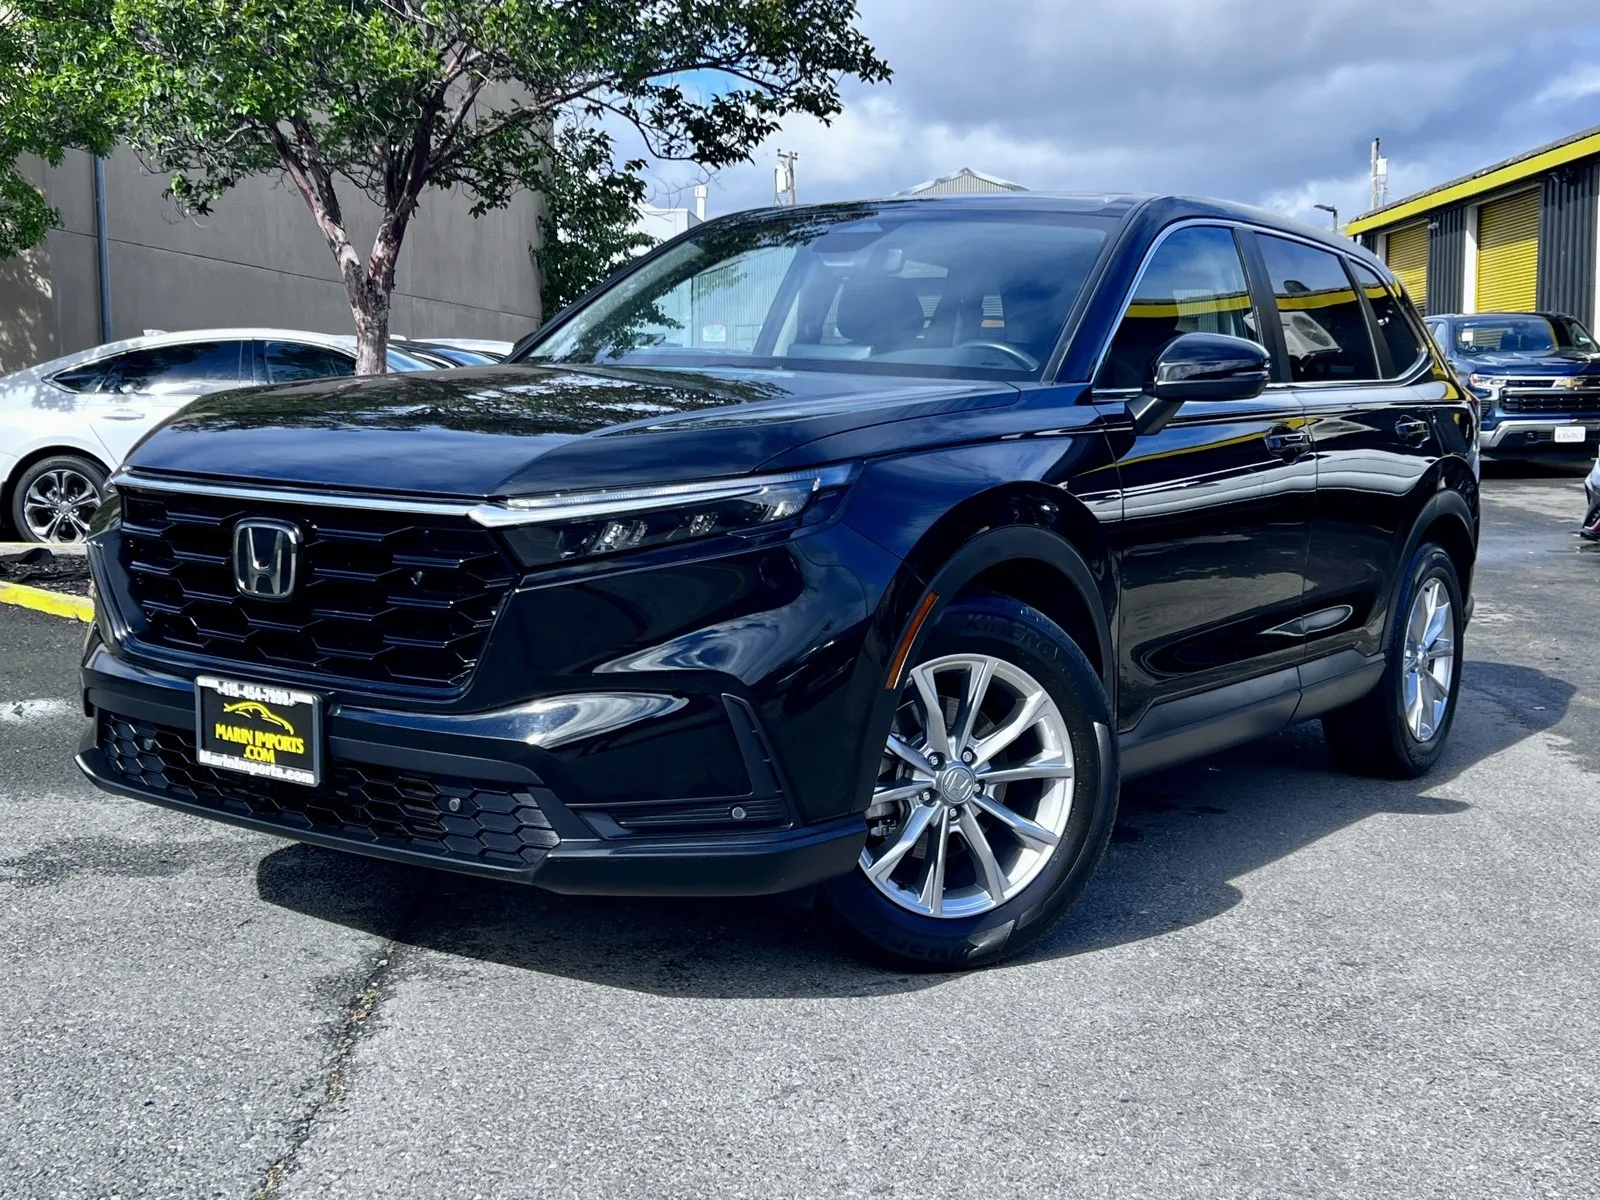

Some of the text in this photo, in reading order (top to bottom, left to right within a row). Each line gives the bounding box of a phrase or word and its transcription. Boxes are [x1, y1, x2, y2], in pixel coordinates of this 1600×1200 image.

[215, 723, 304, 754] MARIN IMPORTS
[244, 745, 276, 764] .COM
